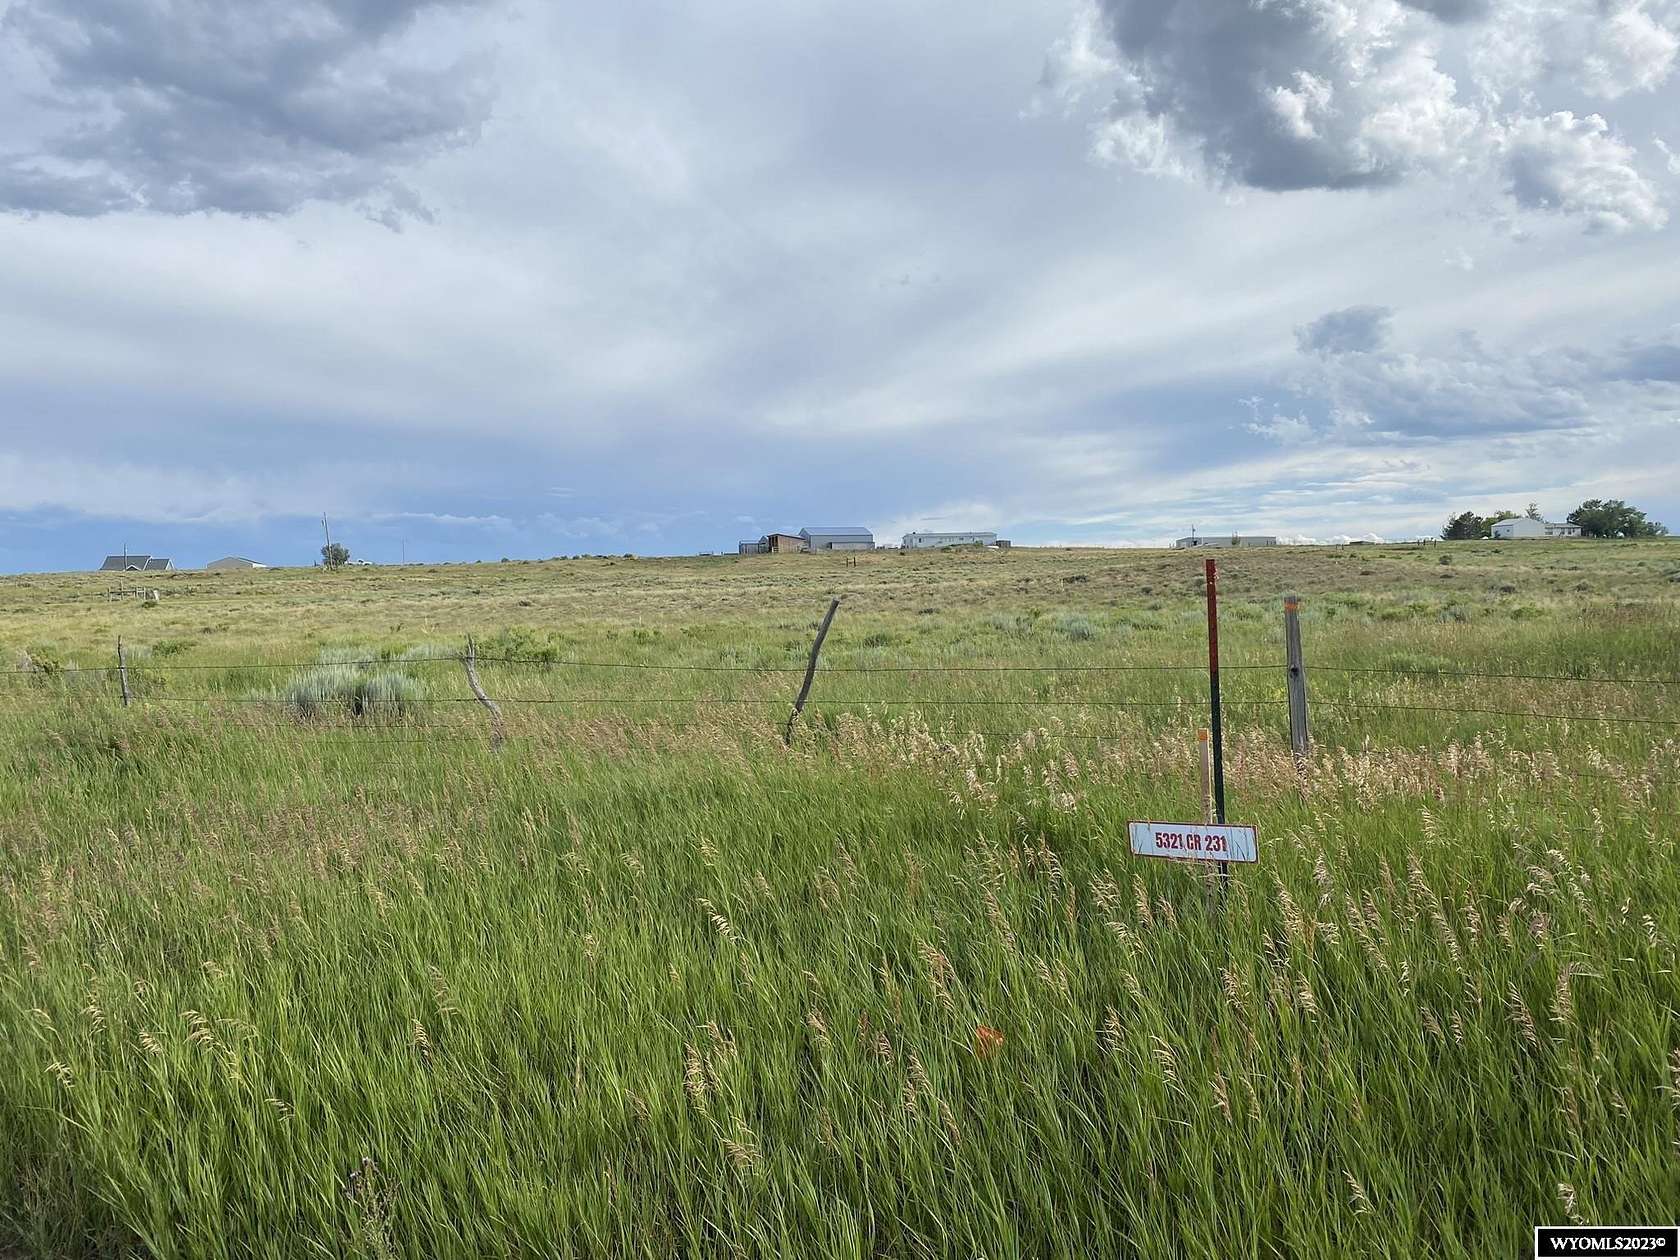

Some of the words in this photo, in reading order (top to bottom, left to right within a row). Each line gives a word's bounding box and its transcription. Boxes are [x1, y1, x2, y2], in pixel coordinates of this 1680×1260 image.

[1155, 832, 1184, 849] 5321
[1186, 834, 1201, 850] CR
[1205, 835, 1227, 851] 231
